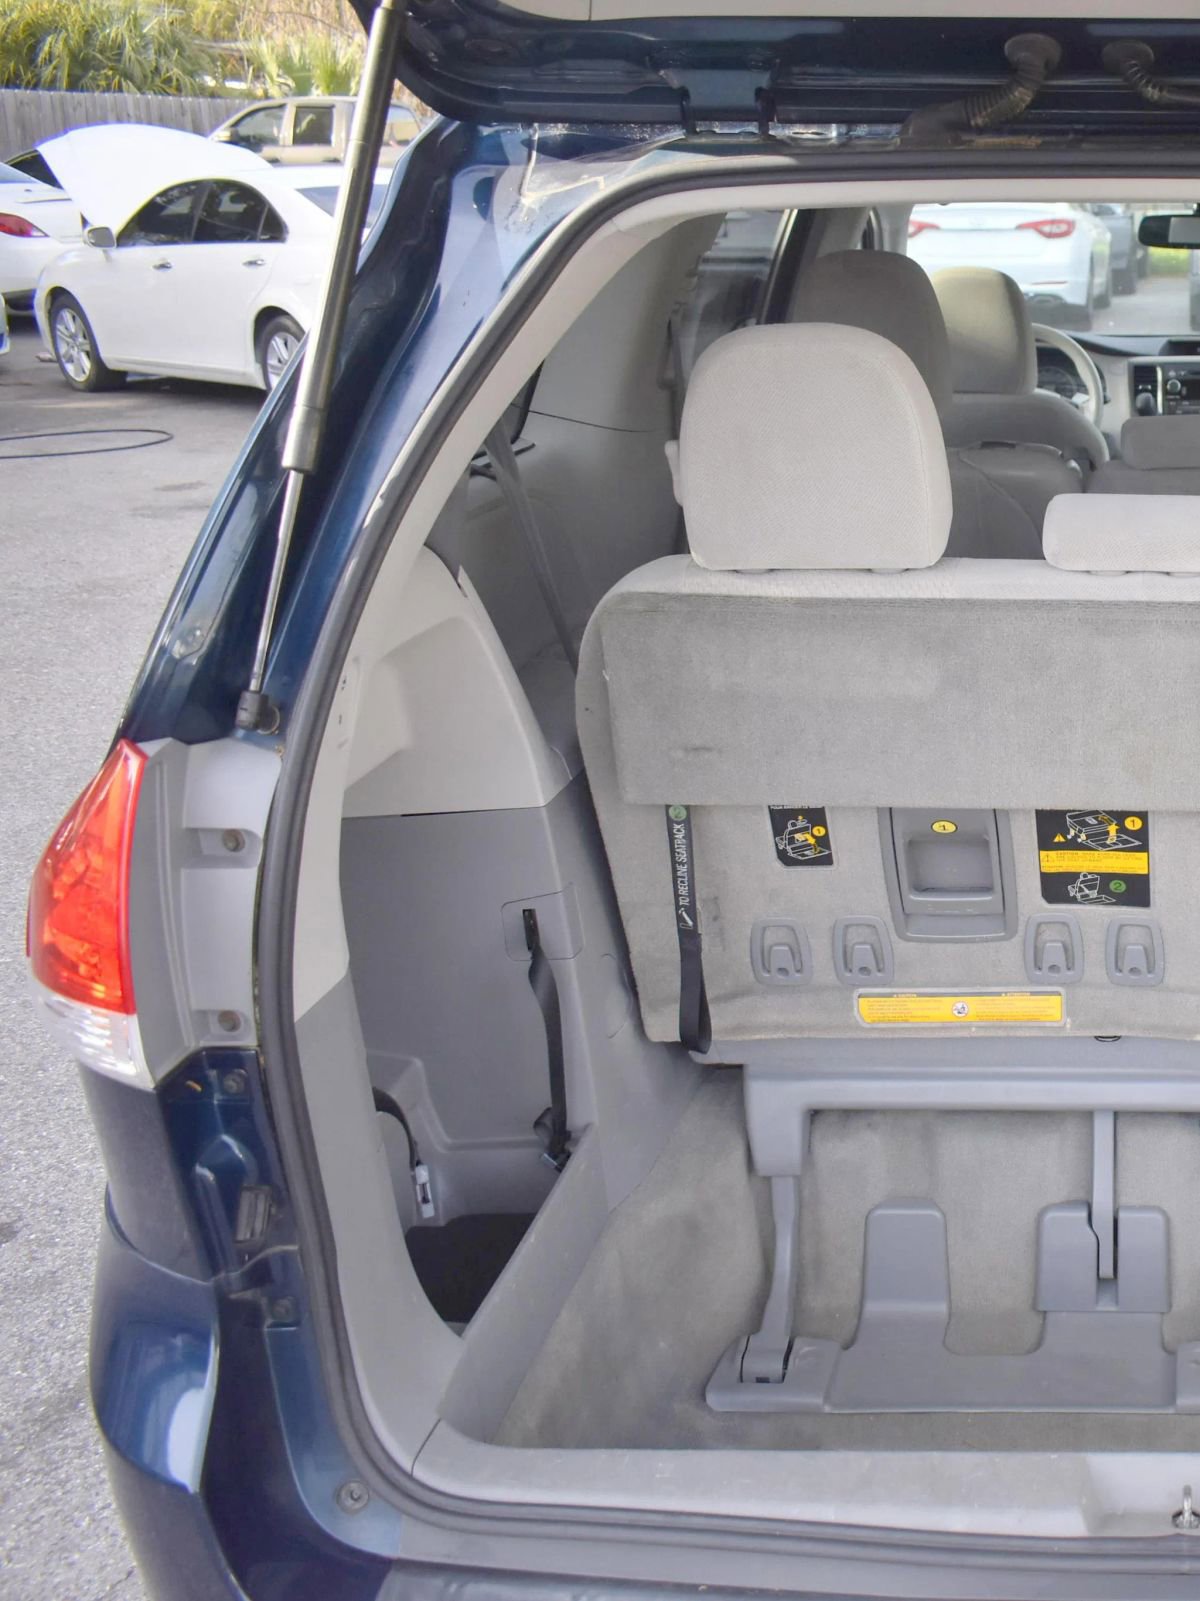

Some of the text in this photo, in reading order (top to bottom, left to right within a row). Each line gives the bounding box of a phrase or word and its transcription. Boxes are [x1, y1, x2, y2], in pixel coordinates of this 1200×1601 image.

[673, 823, 690, 906] TO RECLINE SEATBACK
